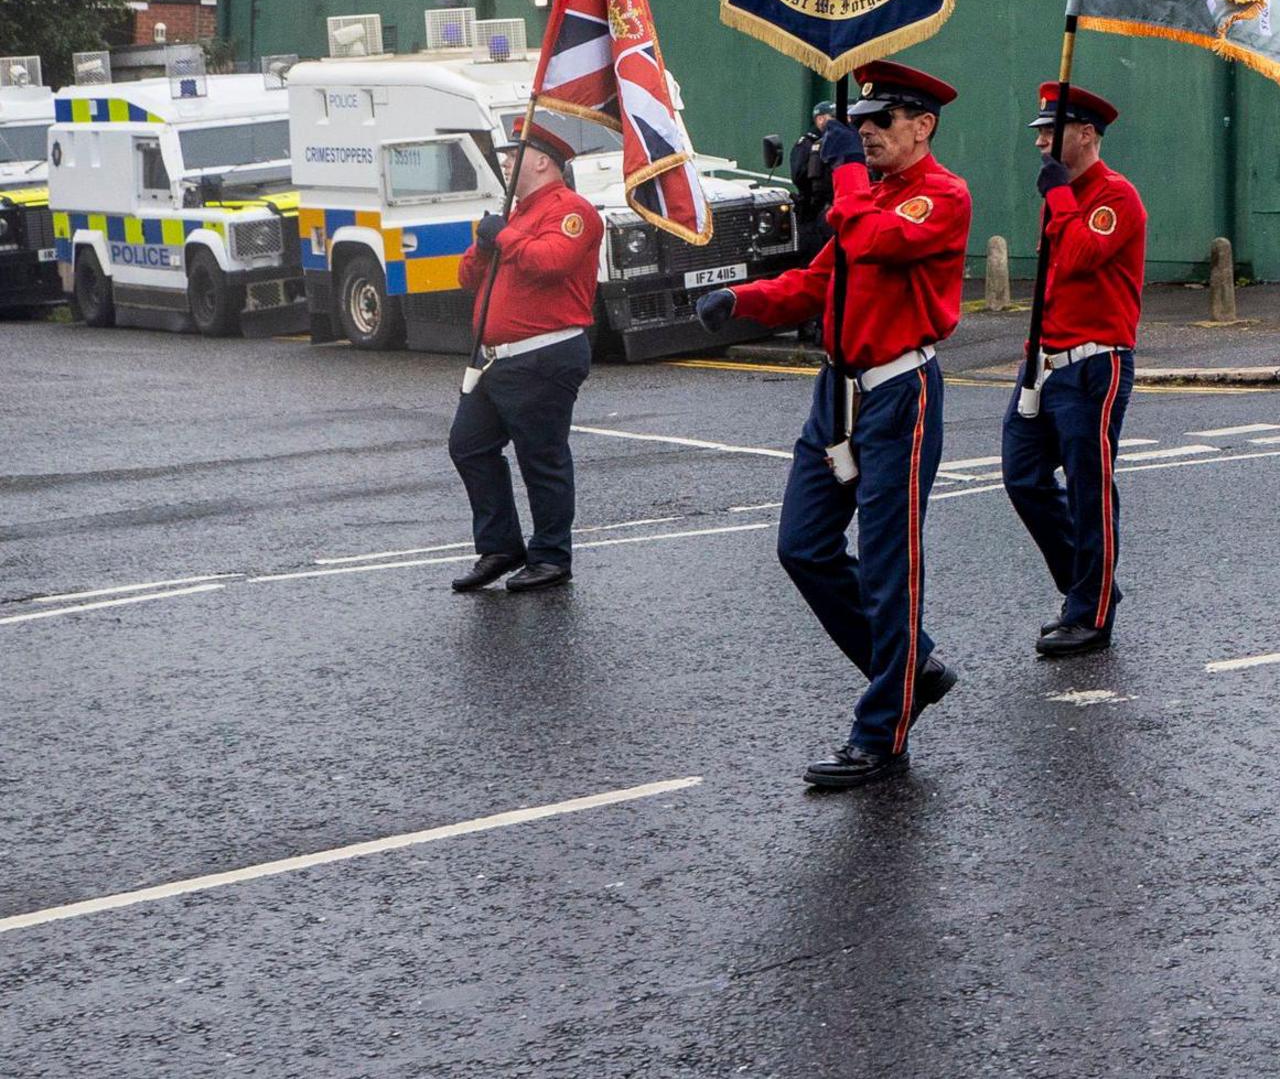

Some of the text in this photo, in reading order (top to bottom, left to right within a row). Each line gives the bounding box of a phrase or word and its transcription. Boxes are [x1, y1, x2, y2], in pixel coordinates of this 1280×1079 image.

[329, 93, 359, 108] POLICE
[305, 146, 374, 165] CRIMESTOPPERS
[111, 245, 170, 267] POLICE
[717, 267, 736, 280] 4115
